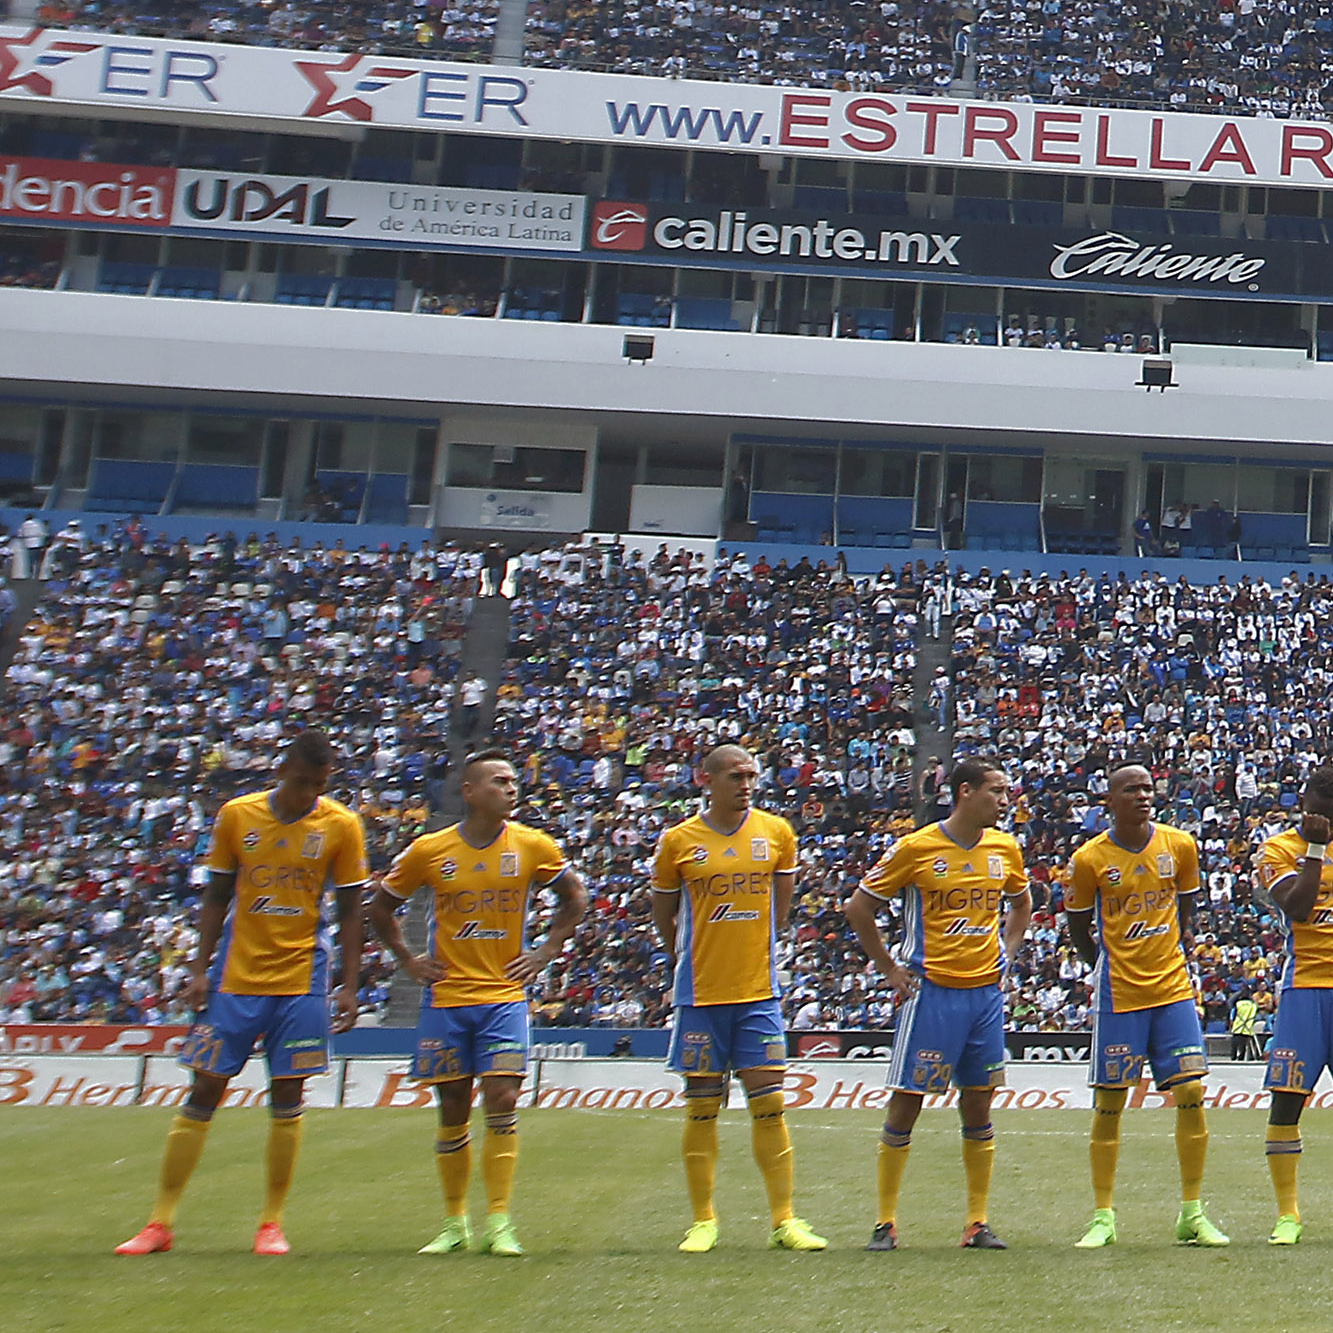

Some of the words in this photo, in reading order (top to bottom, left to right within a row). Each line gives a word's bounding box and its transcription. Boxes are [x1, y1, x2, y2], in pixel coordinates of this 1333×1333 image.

[99, 45, 220, 104] ER
[416, 72, 530, 127] ER
[182, 176, 358, 228] UDAL
[388, 191, 573, 221] Universidad
[379, 216, 404, 232] de
[411, 218, 500, 239] América
[507, 223, 572, 242] Latina
[652, 209, 960, 267] caliente.mx
[1050, 231, 1267, 285] Caliente
[927, 888, 1001, 911] TIGRE
[1107, 887, 1174, 917] TIGRE
[701, 1044, 713, 1072] 6
[1286, 1060, 1306, 1088] 16
